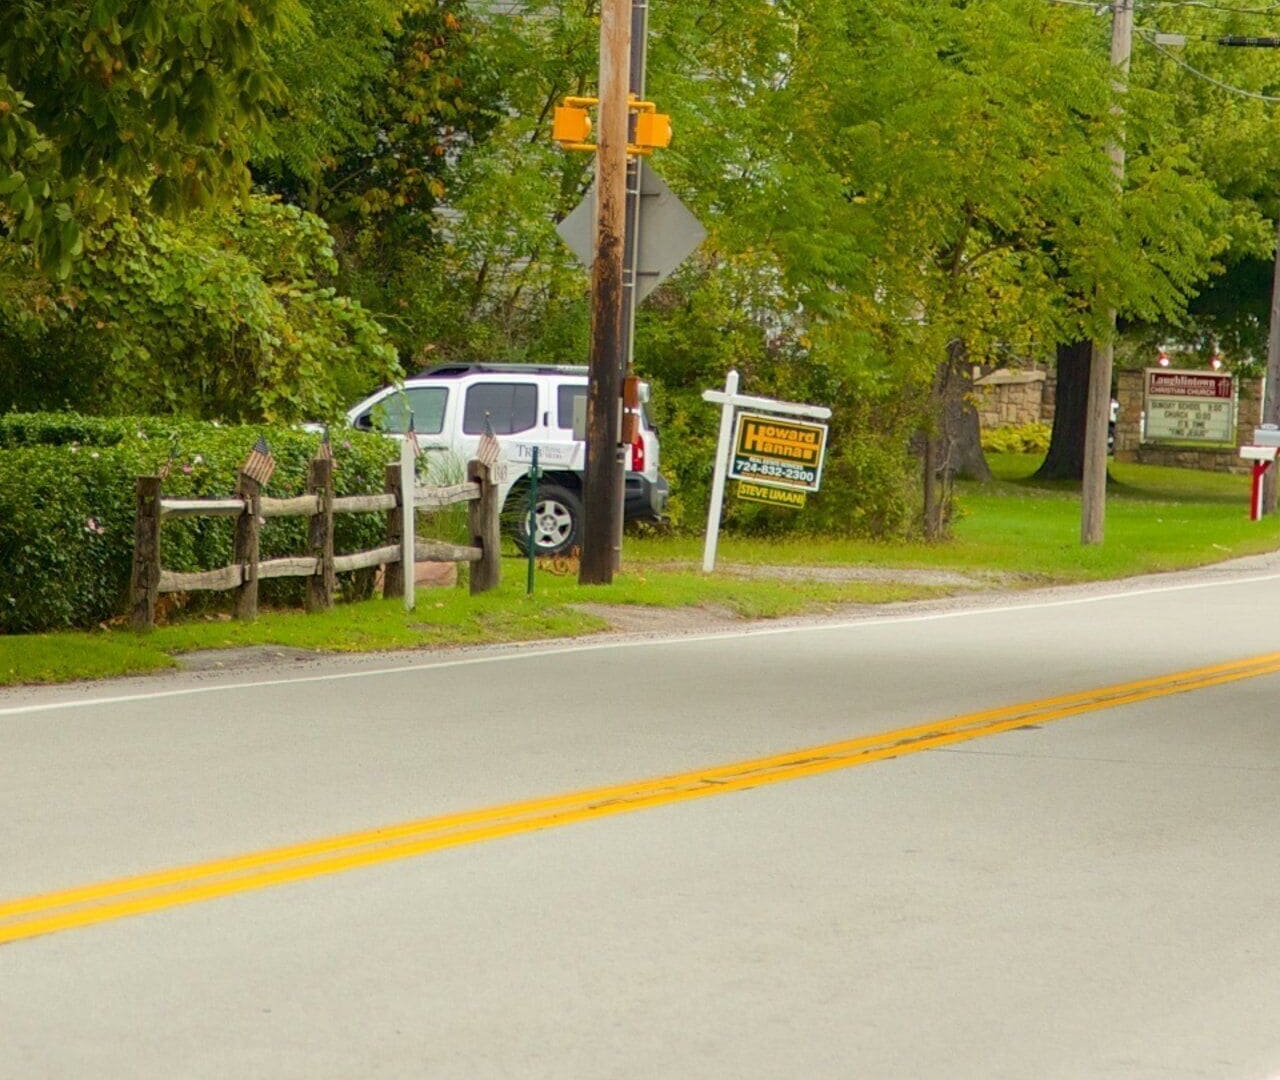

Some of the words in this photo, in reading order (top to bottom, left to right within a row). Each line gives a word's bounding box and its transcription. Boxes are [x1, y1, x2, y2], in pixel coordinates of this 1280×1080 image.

[1151, 374, 1216, 387] Laughlintown
[1150, 386, 1186, 395] CHRISTIAN
[1187, 388, 1216, 396] CHURCH
[745, 423, 816, 445] Howard
[736, 460, 814, 482] 724-832-2300
[740, 484, 769, 499] STEVE
